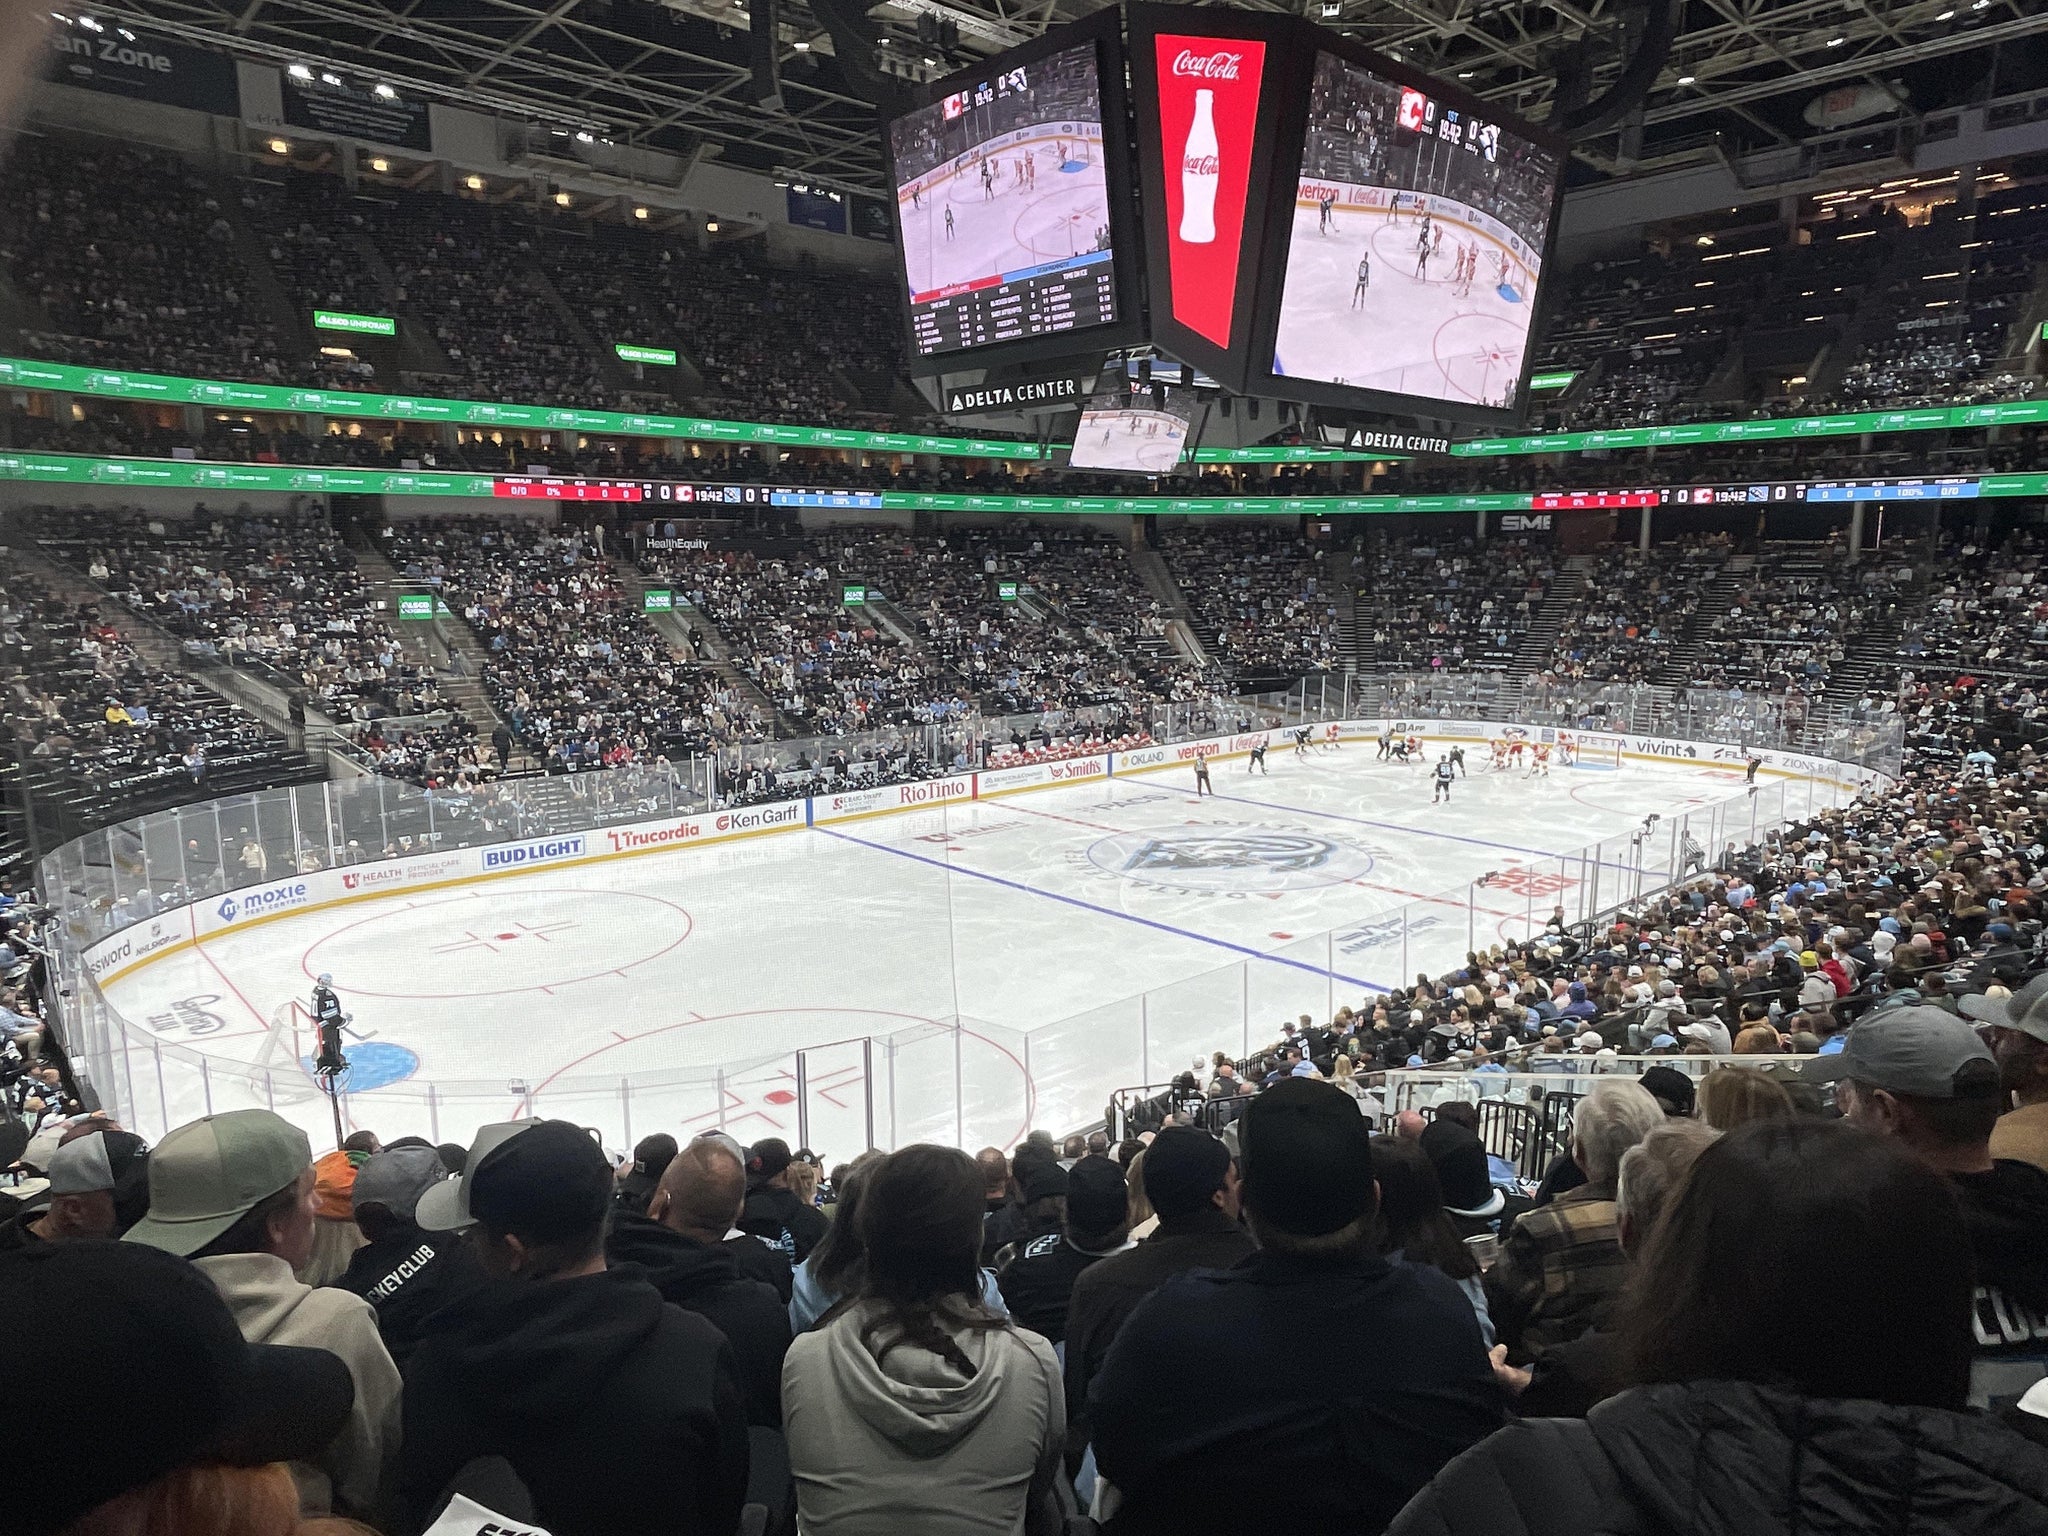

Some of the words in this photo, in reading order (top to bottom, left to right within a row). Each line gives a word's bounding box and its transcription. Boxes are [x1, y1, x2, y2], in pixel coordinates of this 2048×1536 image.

[98, 38, 173, 73] Zone
[1172, 49, 1243, 80] Coca-Cola
[998, 75, 1006, 91] 0
[962, 90, 969, 105] 0
[1425, 101, 1435, 122] 0
[1439, 119, 1462, 145] 19:42
[1469, 120, 1478, 140] 0
[965, 388, 1013, 408] DELTA
[1016, 379, 1075, 401] CENTER
[1364, 432, 1404, 449] DELTA
[1406, 436, 1448, 453] CENTER
[695, 490, 723, 502] 19:42
[745, 488, 755, 502] 0
[1677, 489, 1688, 502] 0
[1715, 491, 1747, 502] 19:42
[1775, 486, 1786, 500] 0
[646, 538, 708, 551] HealthEquity
[1177, 742, 1219, 760] verizon
[1235, 734, 1263, 751] Coca-Cola
[1131, 751, 1164, 766] OKLAND
[1782, 757, 1816, 771] ZIONS
[1065, 760, 1101, 778] Smith's
[731, 808, 760, 829] Ken
[762, 805, 799, 824] Garff
[621, 823, 700, 848] Trucordia
[486, 848, 526, 867] BUD
[528, 839, 582, 862] LIGHT
[363, 868, 402, 882] HEALTH
[244, 883, 307, 910] moxie
[245, 906, 265, 916] PEST
[268, 897, 308, 912] CONTROL
[398, 1244, 436, 1279] CLUB
